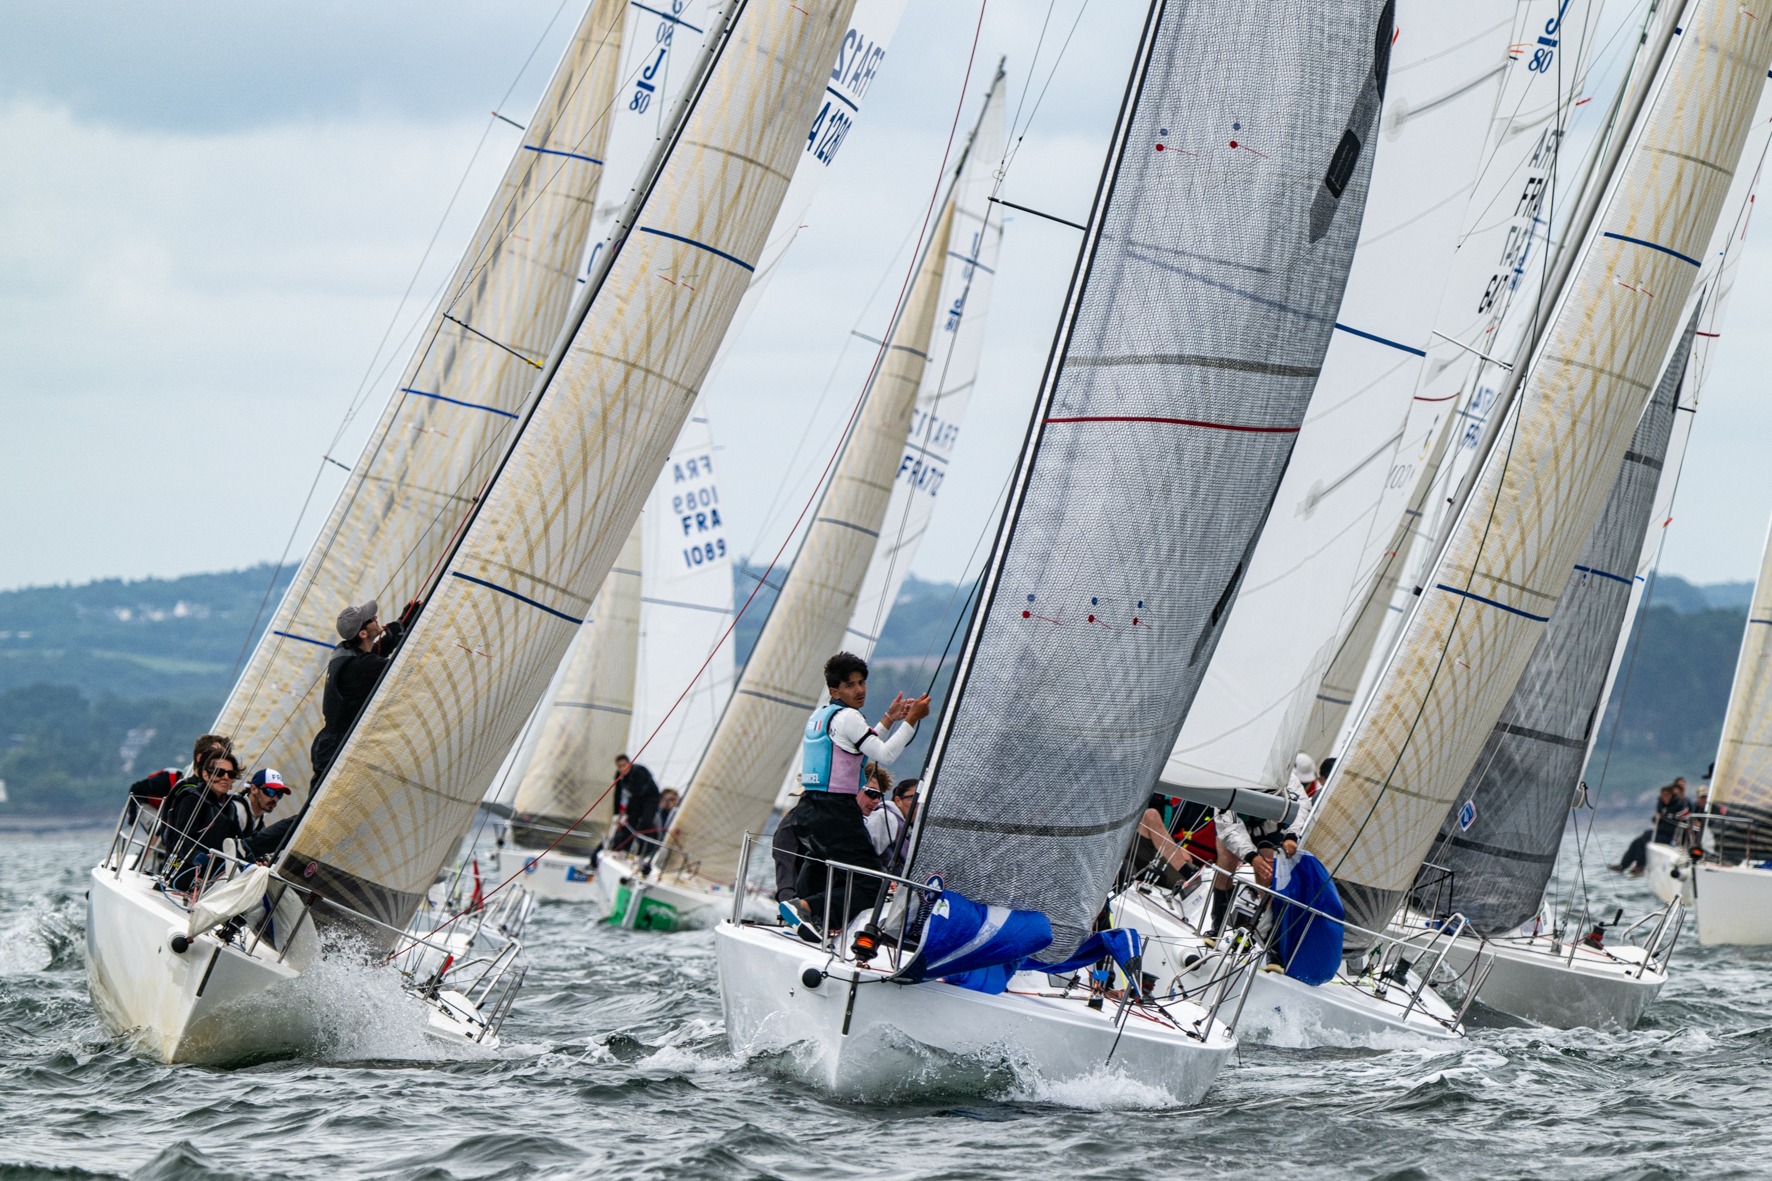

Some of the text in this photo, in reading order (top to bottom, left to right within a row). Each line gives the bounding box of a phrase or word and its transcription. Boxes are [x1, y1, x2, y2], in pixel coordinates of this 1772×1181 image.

[643, 48, 667, 81] J
[1528, 48, 1554, 74] 80
[629, 90, 651, 114] 80
[682, 508, 722, 536] FRA
[683, 538, 727, 568] 1089
